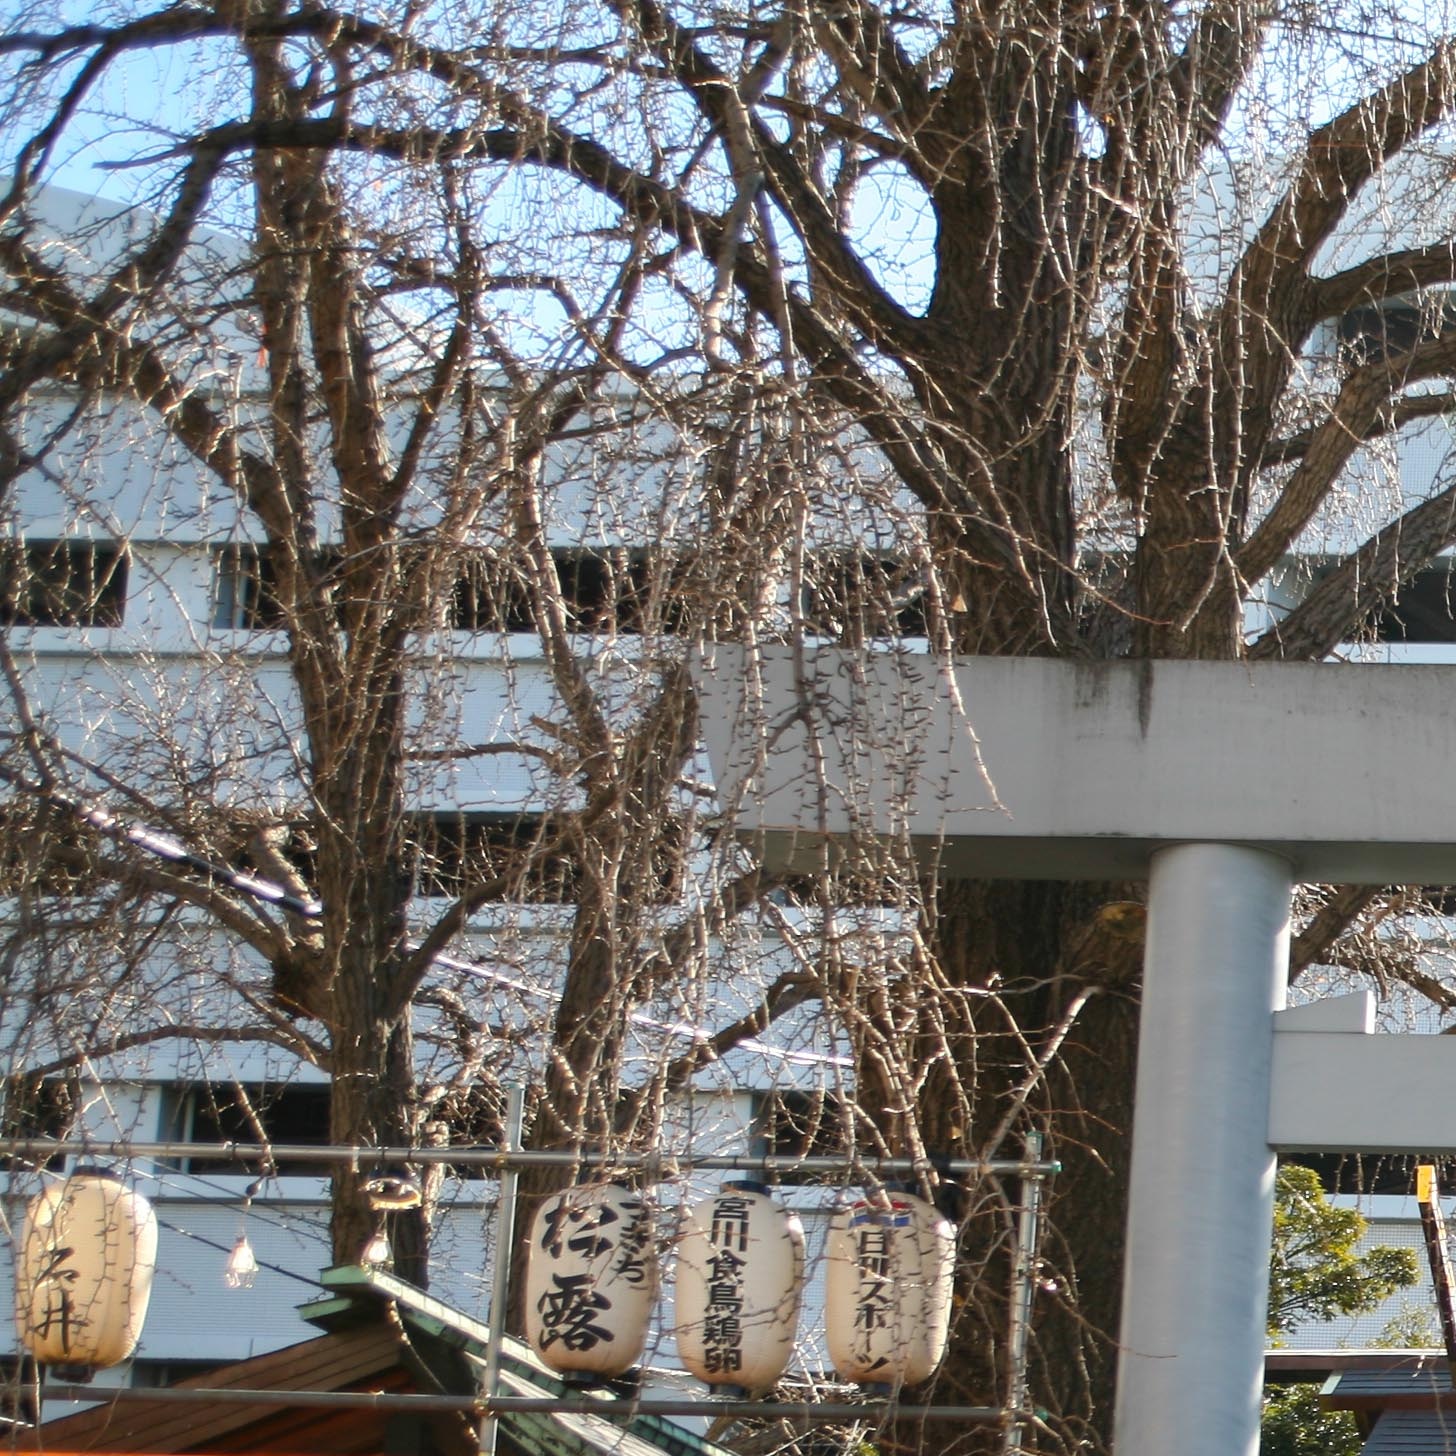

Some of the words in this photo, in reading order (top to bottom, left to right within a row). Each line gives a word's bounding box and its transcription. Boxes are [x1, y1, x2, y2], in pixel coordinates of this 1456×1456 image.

[539, 1203, 616, 1353] 松露
[703, 1197, 756, 1375] 宮川食鳥鶏卵
[853, 1230, 892, 1374] 日刊スポーツ
